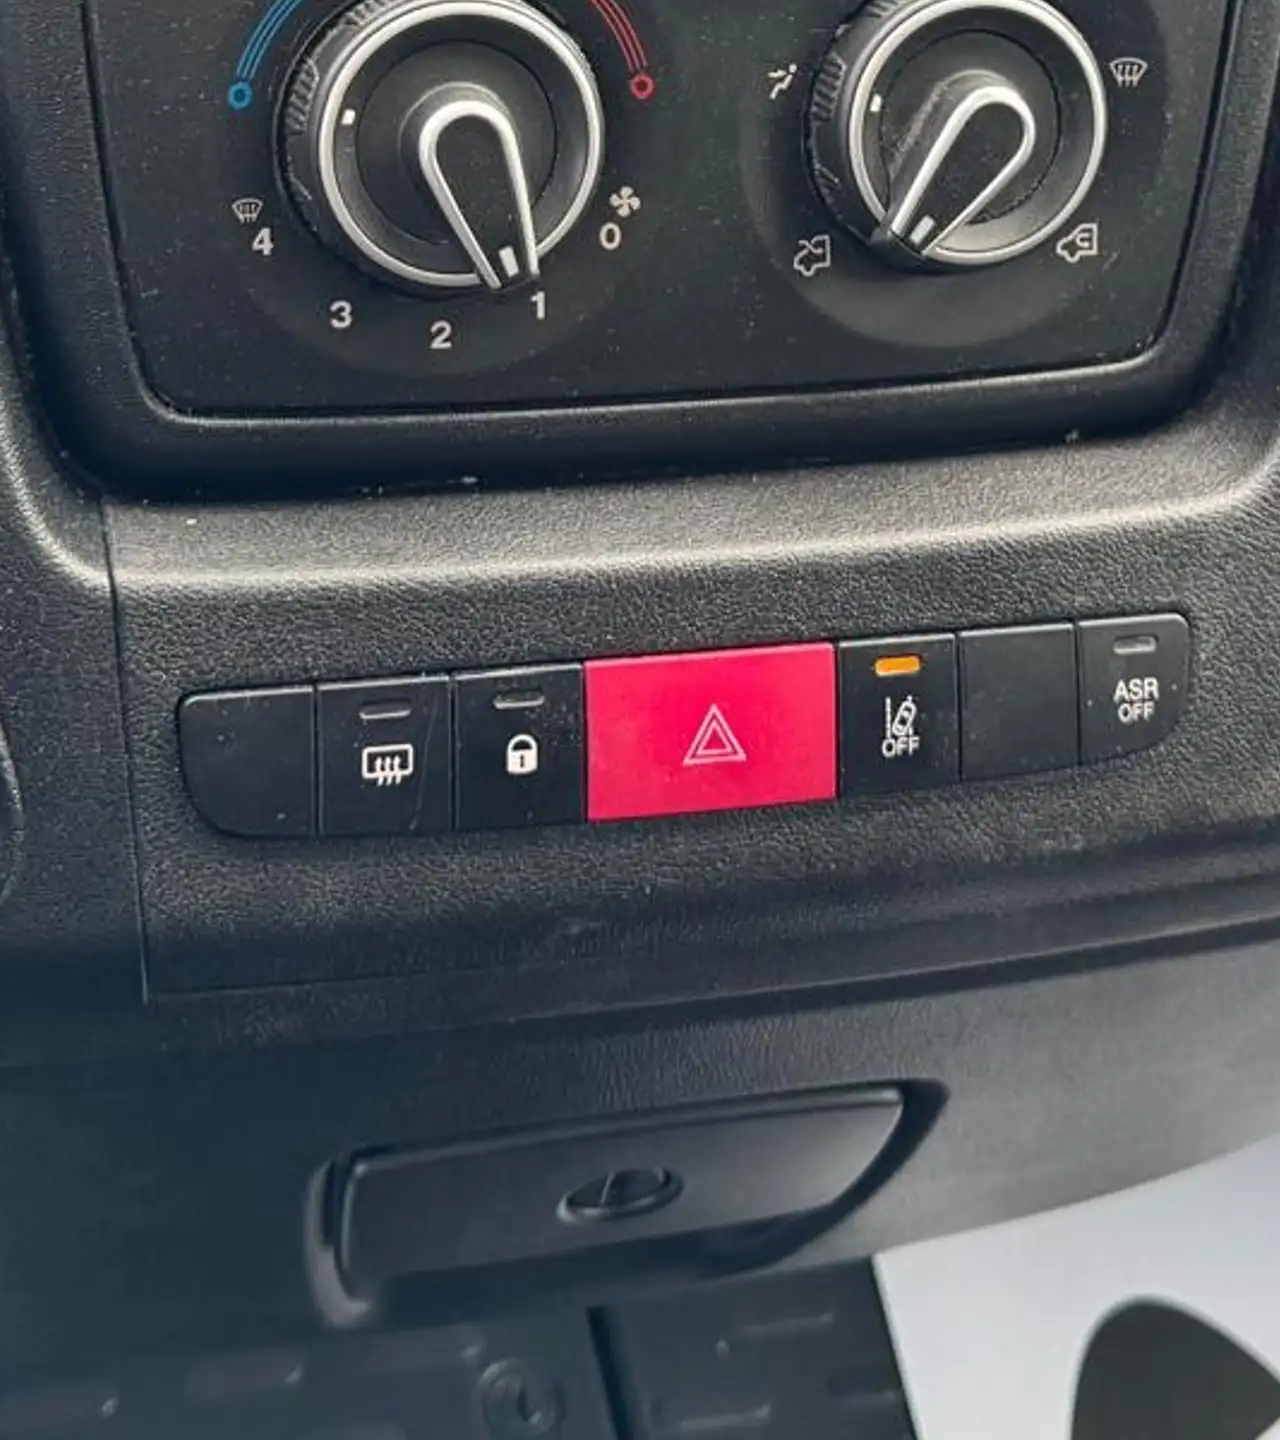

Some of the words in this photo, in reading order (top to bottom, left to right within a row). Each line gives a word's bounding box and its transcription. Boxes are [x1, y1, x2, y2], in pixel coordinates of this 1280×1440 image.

[252, 228, 274, 255] 4
[599, 221, 622, 250] 0
[329, 300, 354, 328] 3
[529, 291, 547, 319] 1
[429, 320, 453, 349] 2
[1113, 677, 1160, 701] ASR
[1117, 702, 1155, 725] OFF
[881, 736, 920, 758] OFF
